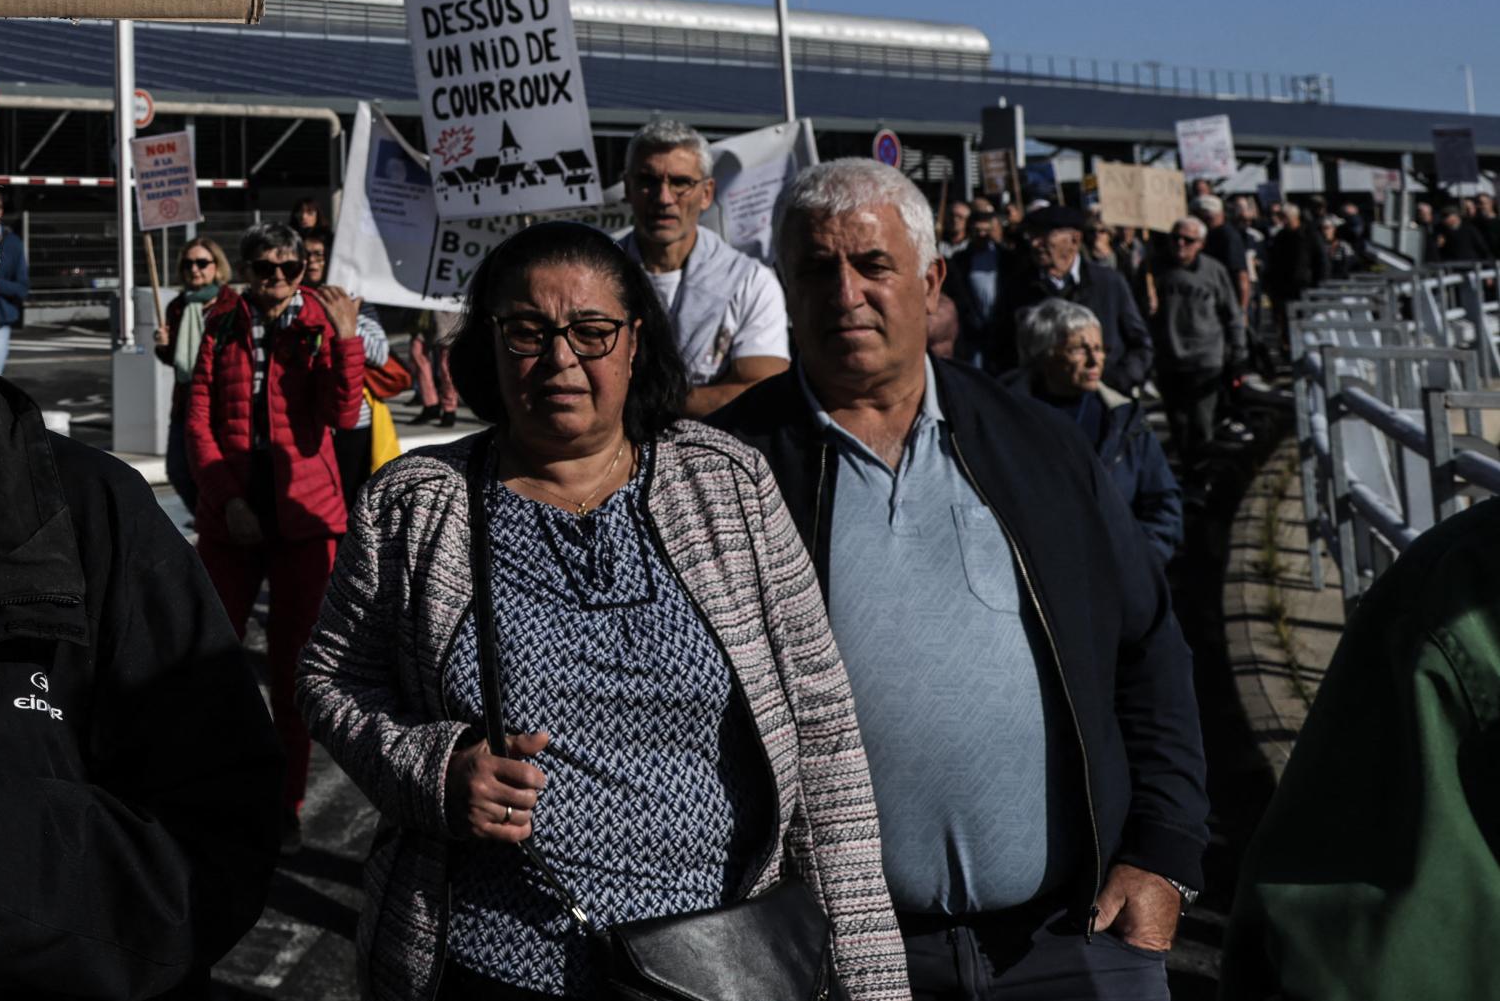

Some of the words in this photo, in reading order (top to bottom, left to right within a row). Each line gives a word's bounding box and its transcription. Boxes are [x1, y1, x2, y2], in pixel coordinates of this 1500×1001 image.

[427, 43, 463, 79] UN
[525, 27, 561, 66] DE
[431, 69, 573, 121] COURROUX
[145, 141, 177, 157] NON
